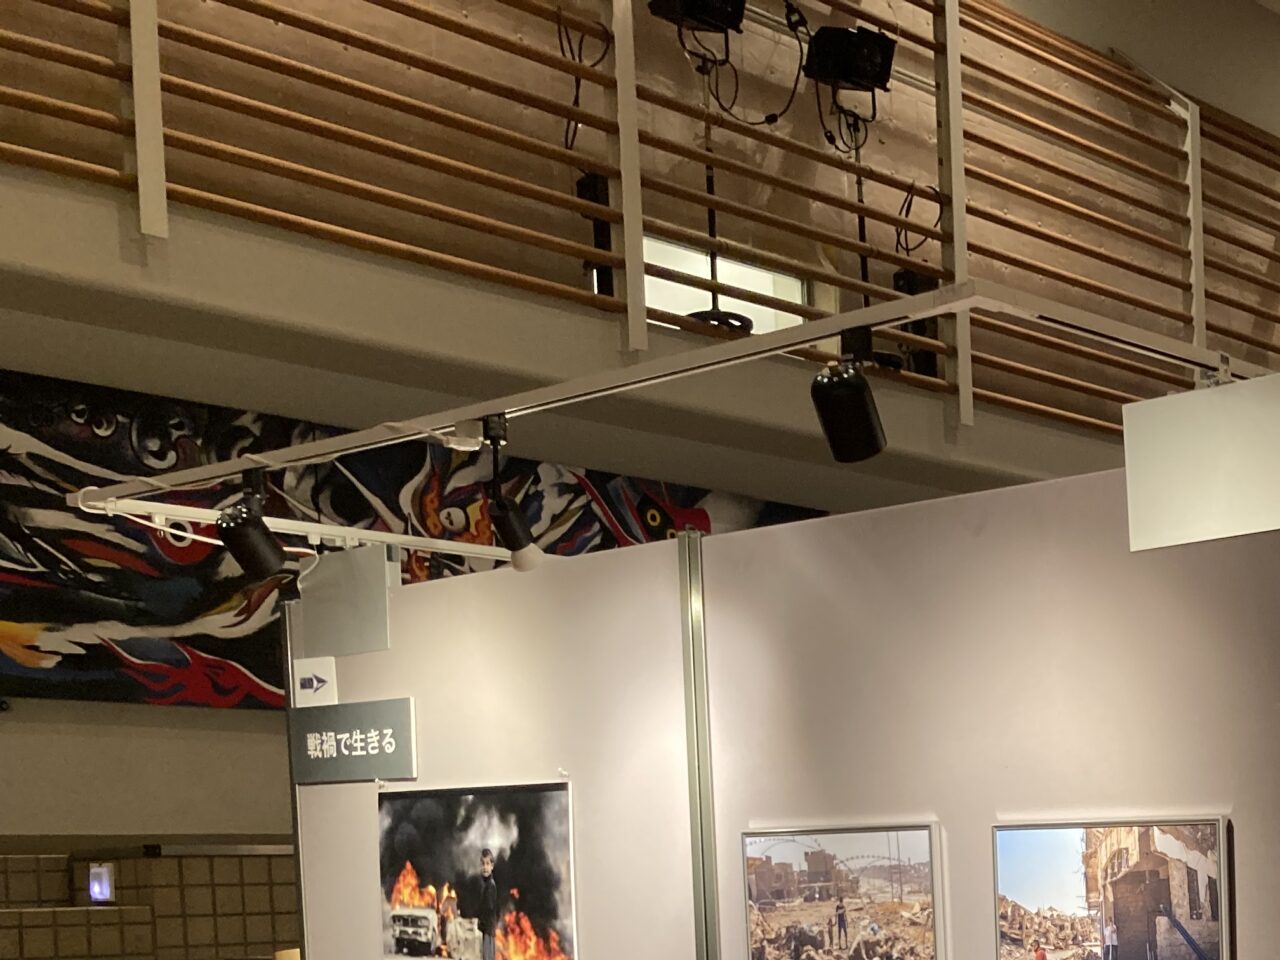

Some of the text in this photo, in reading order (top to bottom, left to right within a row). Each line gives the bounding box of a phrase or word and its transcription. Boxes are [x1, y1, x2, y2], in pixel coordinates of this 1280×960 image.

[307, 728, 396, 759] 戦禍で生きる
